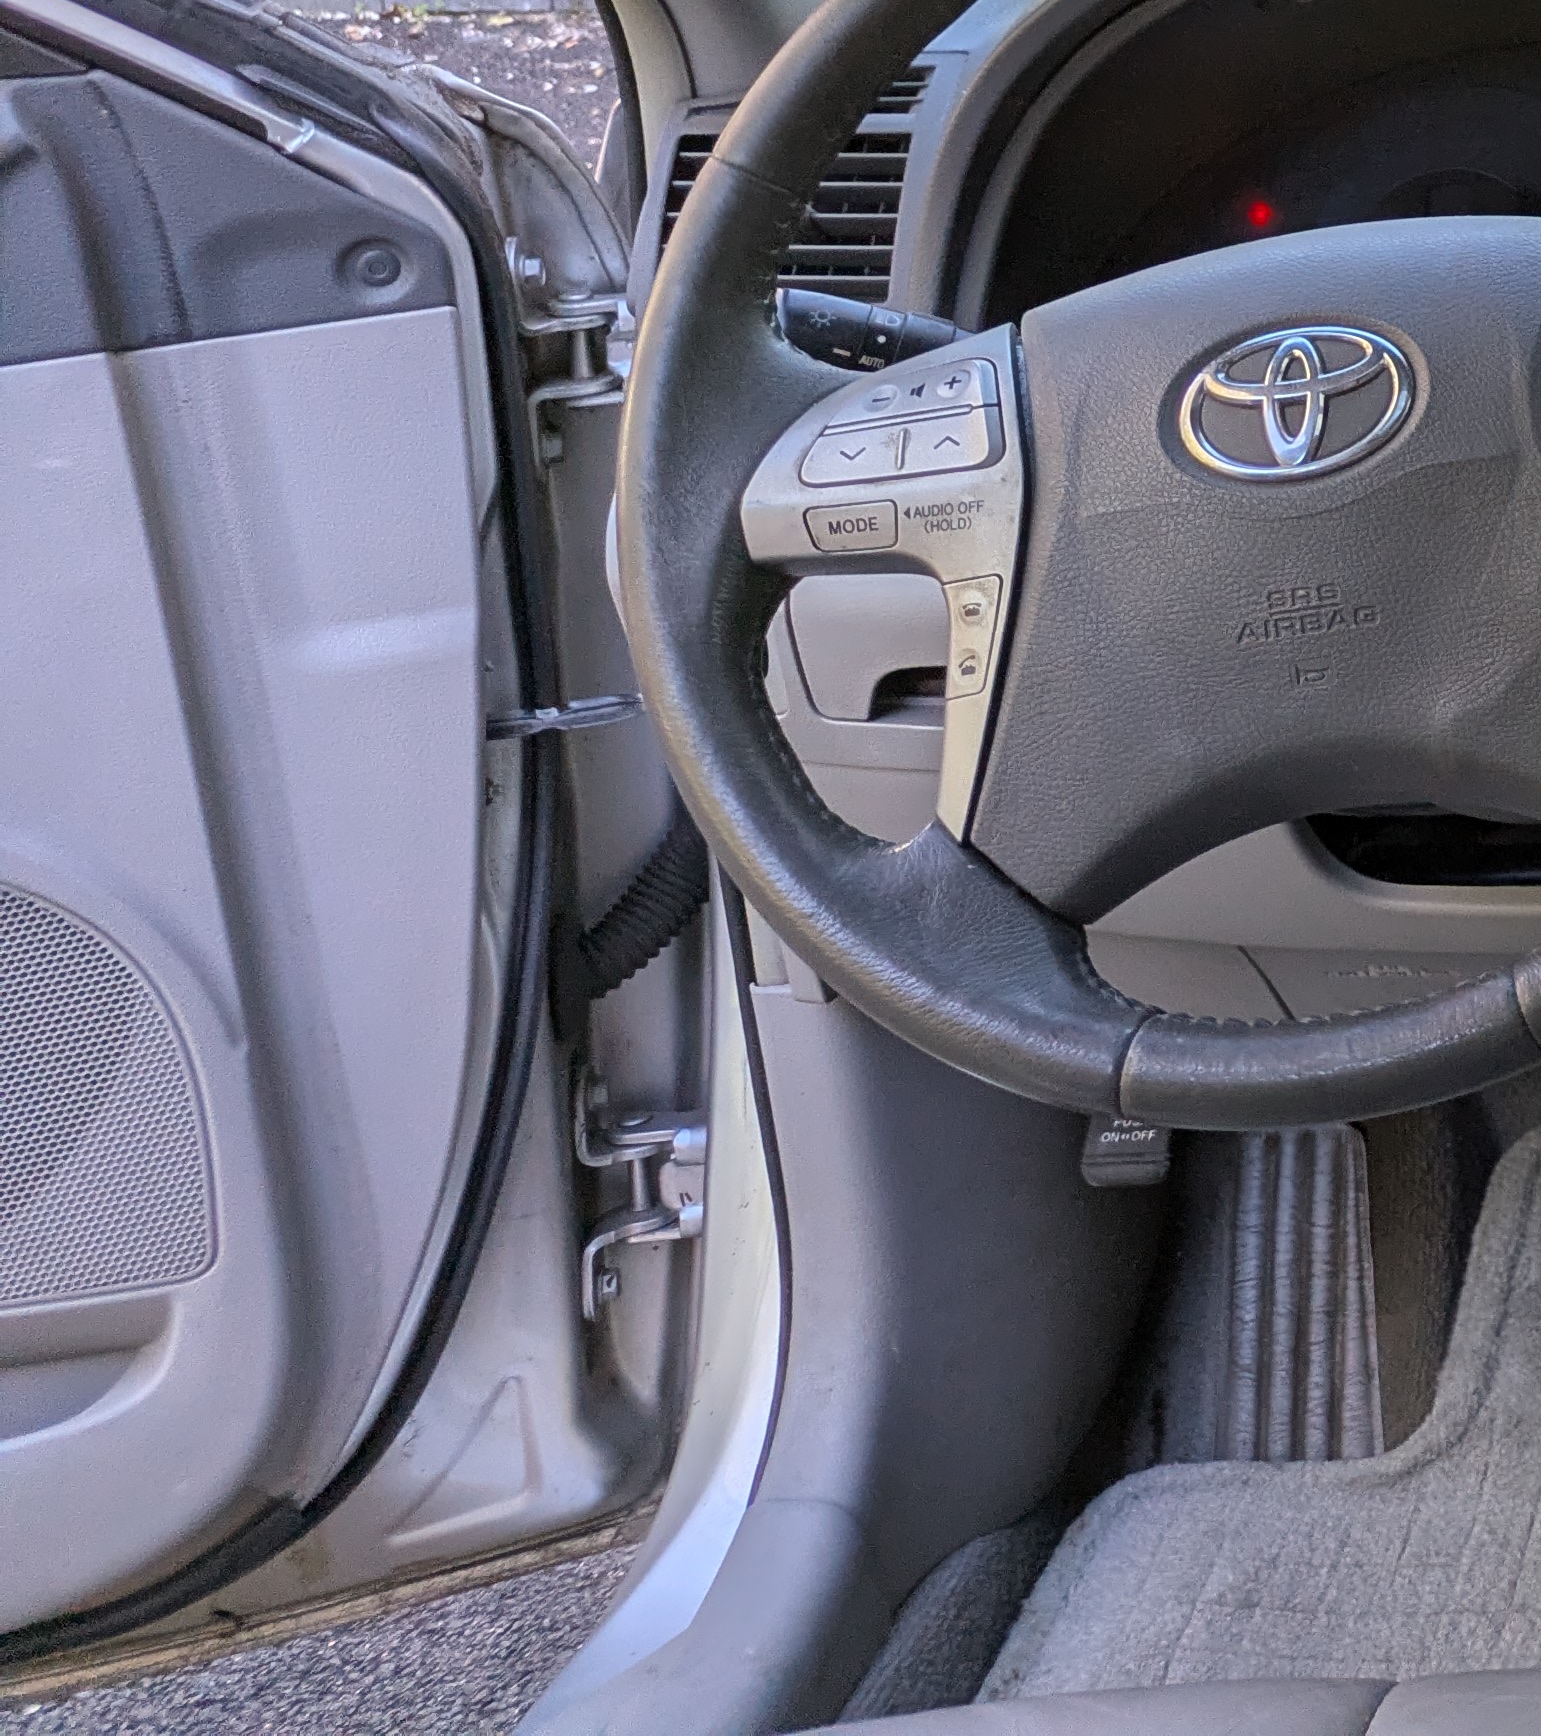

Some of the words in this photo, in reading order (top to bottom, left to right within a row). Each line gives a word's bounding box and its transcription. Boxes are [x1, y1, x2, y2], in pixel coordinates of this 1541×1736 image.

[858, 354, 885, 368] AUTO
[914, 503, 953, 519] AUDIO
[957, 499, 985, 514] OFF
[828, 516, 879, 536] MODE
[924, 516, 973, 534] (HOLD)
[1266, 582, 1341, 611] SRS
[1236, 604, 1382, 645] AIRBAG
